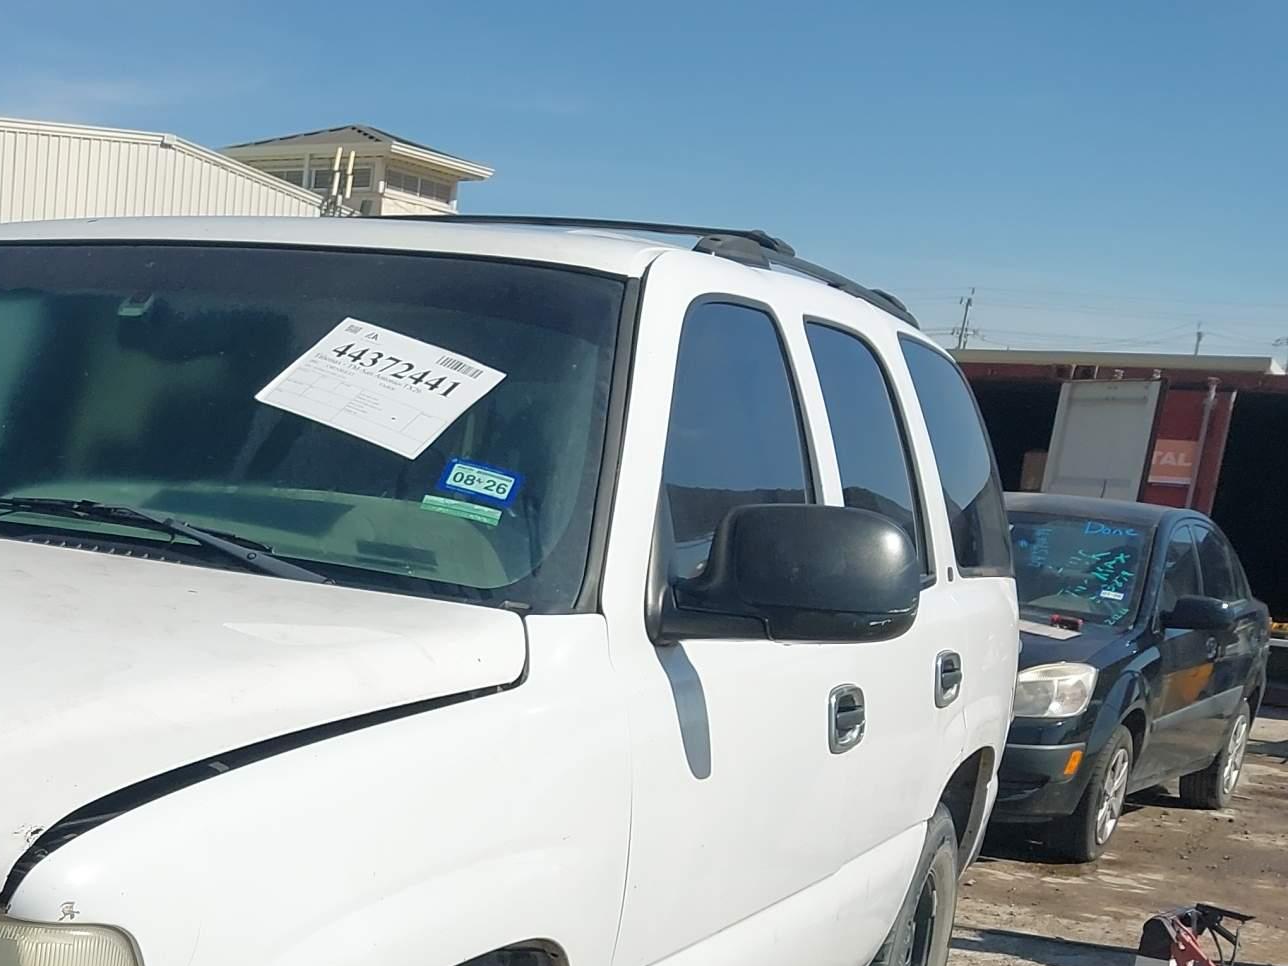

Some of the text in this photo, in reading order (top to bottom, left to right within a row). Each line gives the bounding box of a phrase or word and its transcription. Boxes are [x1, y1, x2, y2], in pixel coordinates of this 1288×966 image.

[332, 343, 462, 398] 44372441
[452, 471, 476, 486] 08
[483, 479, 509, 495] 26
